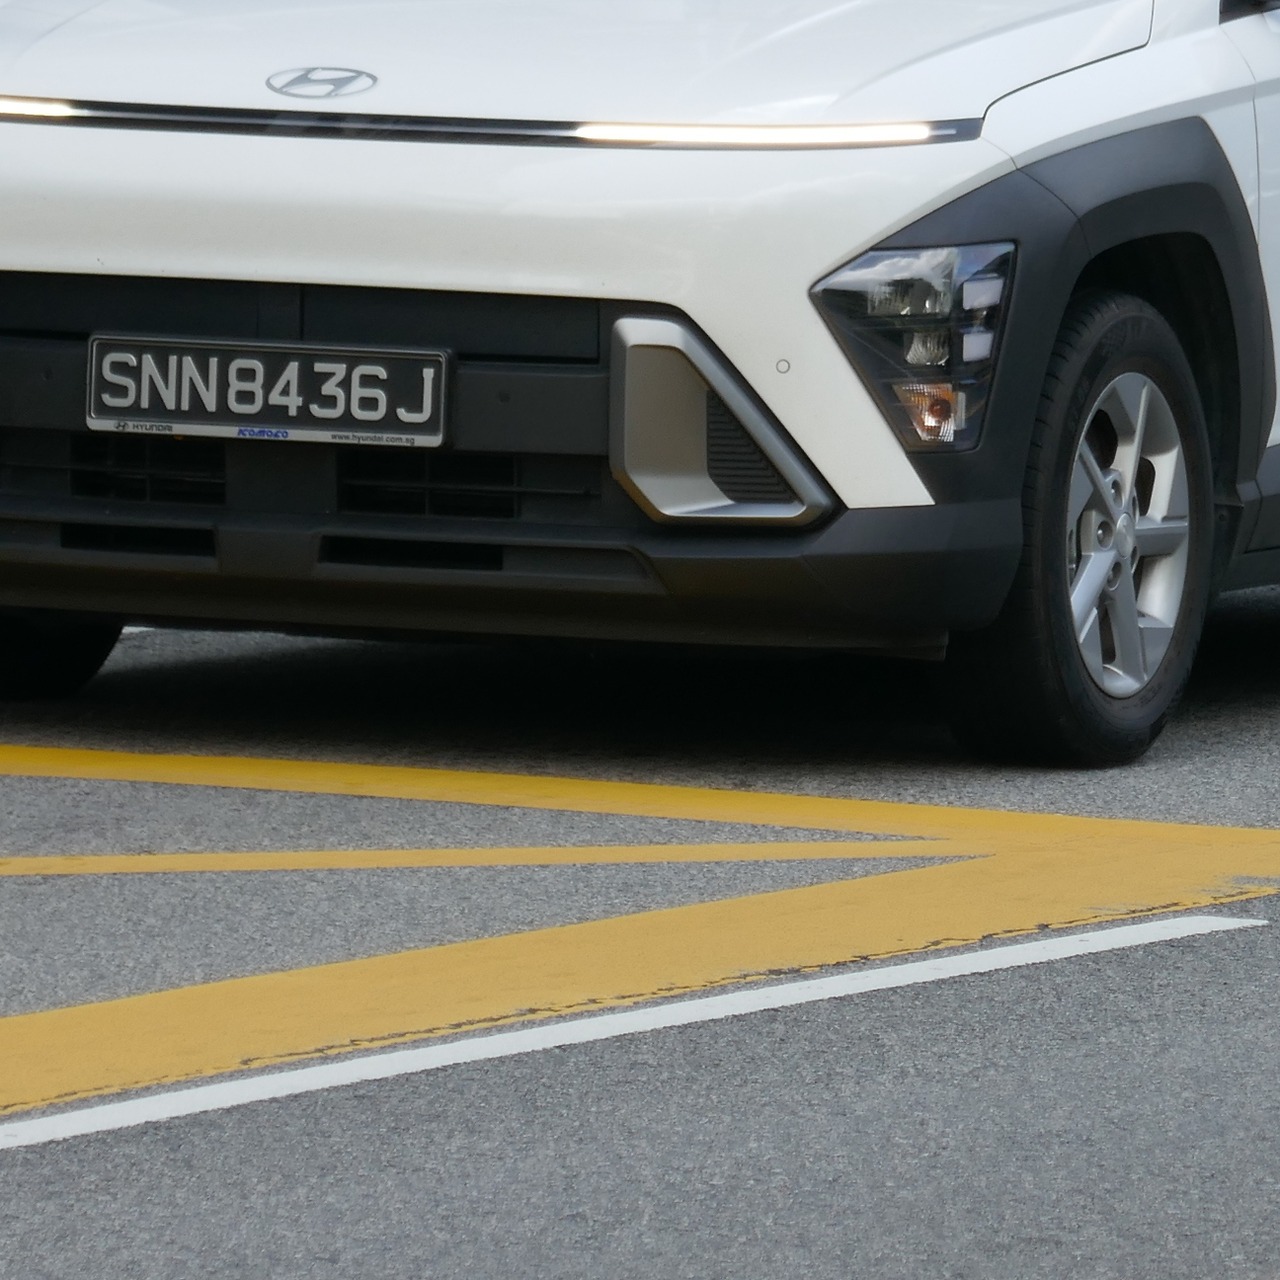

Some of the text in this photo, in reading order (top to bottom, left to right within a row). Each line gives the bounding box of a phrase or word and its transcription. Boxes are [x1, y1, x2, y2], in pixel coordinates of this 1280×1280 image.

[100, 351, 434, 424] SNN8436J
[131, 422, 173, 432] HYUNDAI
[330, 432, 415, 446] www.hyundai.com.sg
